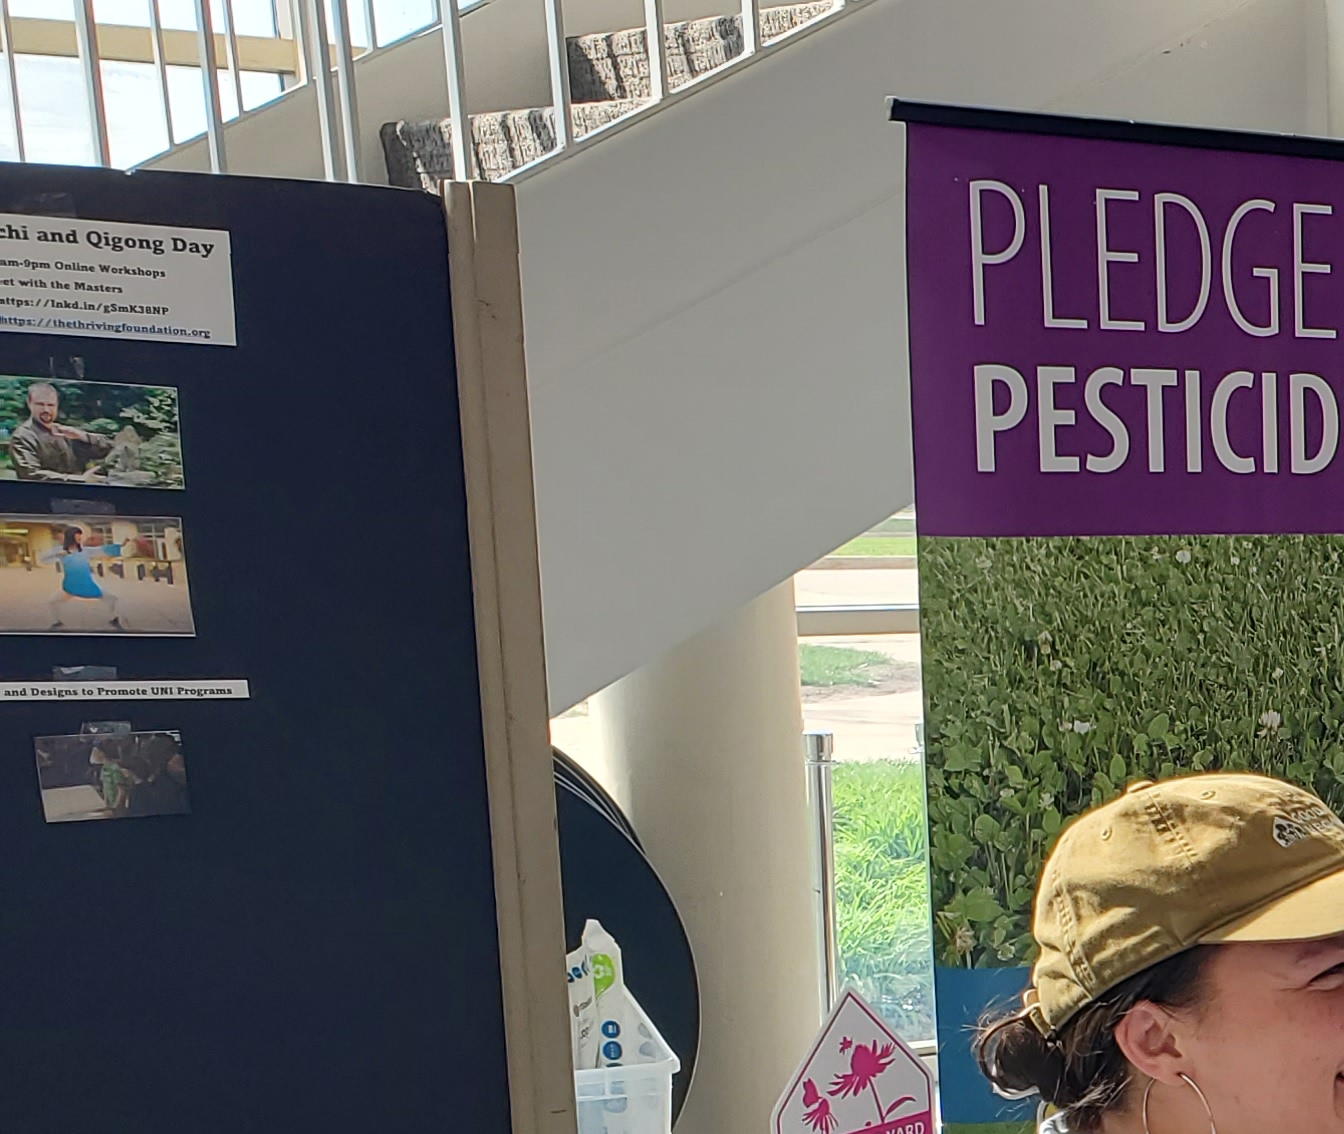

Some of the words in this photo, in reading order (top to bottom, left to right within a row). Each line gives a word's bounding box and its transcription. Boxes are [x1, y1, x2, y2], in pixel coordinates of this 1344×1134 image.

[36, 229, 79, 245] and
[86, 230, 165, 256] Qigong
[170, 236, 215, 258] Day
[969, 180, 1337, 340] PLEDGE
[54, 261, 95, 273] Online
[98, 264, 167, 279] Workshops
[18, 279, 47, 289] with
[50, 280, 71, 291] the
[74, 281, 124, 294] Masters
[4, 687, 27, 697] and
[30, 687, 79, 699] Designs
[81, 688, 95, 697] to
[97, 687, 148, 698] Promote
[151, 686, 174, 696] UNI
[177, 686, 233, 699] Programs
